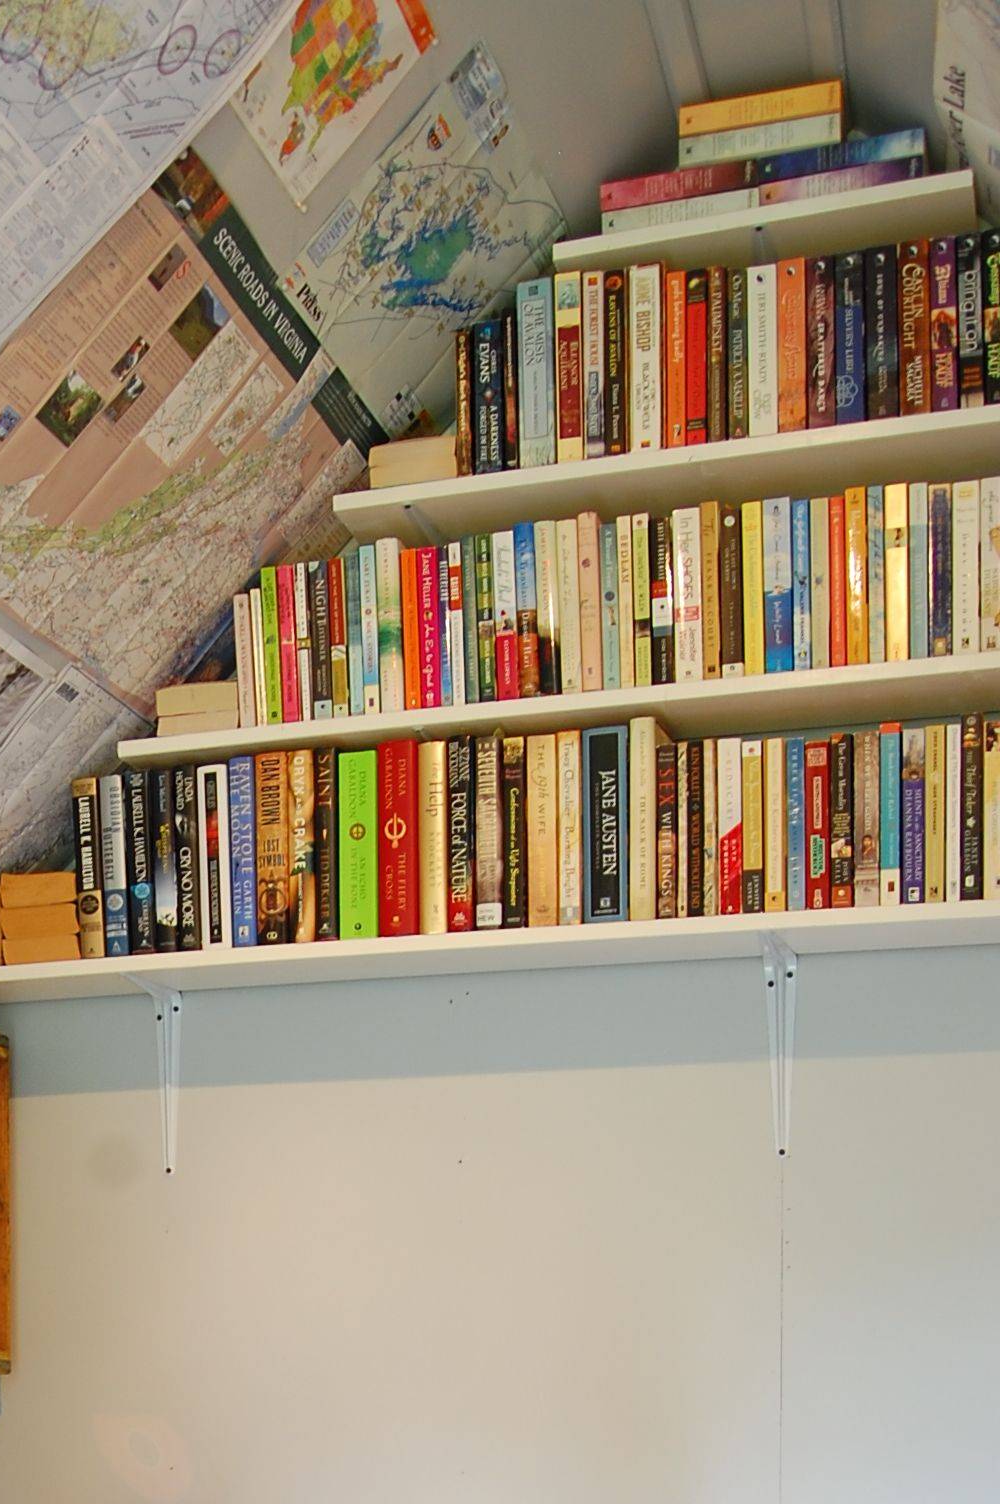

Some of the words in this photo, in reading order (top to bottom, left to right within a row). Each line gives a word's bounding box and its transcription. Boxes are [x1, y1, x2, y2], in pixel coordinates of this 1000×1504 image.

[942, 65, 966, 110] Lake
[213, 227, 245, 274] SCENIC
[237, 263, 270, 308] ROADS
[263, 299, 278, 321] IN
[274, 311, 309, 364] VIRGINIA
[524, 304, 533, 317] OF
[961, 270, 978, 312] bring
[534, 306, 545, 326] THE
[636, 311, 651, 352] BISHOP
[525, 319, 535, 366] AVALON
[535, 332, 545, 364] MISTS
[965, 329, 978, 351] on
[479, 343, 490, 383] EVANS
[490, 414, 498, 460] DARKNESS
[681, 517, 691, 529] In
[681, 532, 692, 554] Her
[421, 552, 432, 576] JANE
[682, 557, 693, 599] SHOES
[315, 579, 327, 626] NIGHT
[422, 577, 433, 609] HELLER
[519, 560, 529, 608] Translator
[523, 646, 532, 668] Hari
[261, 759, 279, 782] DAN
[478, 750, 495, 795] SEVENTH
[537, 745, 545, 768] THE
[562, 741, 574, 767] Tracy
[175, 771, 185, 810] HOWARD
[184, 776, 193, 801] LINDA
[230, 765, 239, 796] THE
[239, 762, 251, 816] RAVEN
[293, 756, 304, 796] ORYX
[317, 754, 332, 809] SAINT
[348, 759, 358, 819] GABALDON
[384, 747, 393, 810] GABALDON
[531, 767, 549, 799] 19th
[563, 769, 575, 817] Chevalier
[600, 770, 616, 810] JANE
[658, 768, 674, 807] SEX
[77, 796, 92, 834] LAURELL
[131, 789, 143, 826] LAURELL
[261, 787, 281, 826] BROWN
[426, 781, 443, 818] Help
[452, 793, 466, 833] FORCE
[231, 805, 241, 858] MOON
[538, 804, 546, 836] WIFE
[661, 811, 672, 848] WITH
[103, 827, 114, 881] BUTTERFLY
[133, 835, 145, 882] HAMILTON
[180, 847, 192, 871] CRY
[242, 824, 253, 874] STOLE
[294, 818, 306, 869] CRAKE
[320, 848, 331, 870] TED
[452, 834, 464, 846] of
[601, 813, 617, 876] AUSTEN
[81, 847, 94, 890] HAMILTON
[180, 871, 192, 891] NO
[385, 865, 393, 901] CROSS
[397, 852, 406, 876] THE
[452, 849, 467, 903] NATURE
[661, 854, 672, 896] KINGS
[182, 893, 194, 927] MORE
[243, 880, 252, 919] GARTH
[398, 879, 407, 912] FIERY
